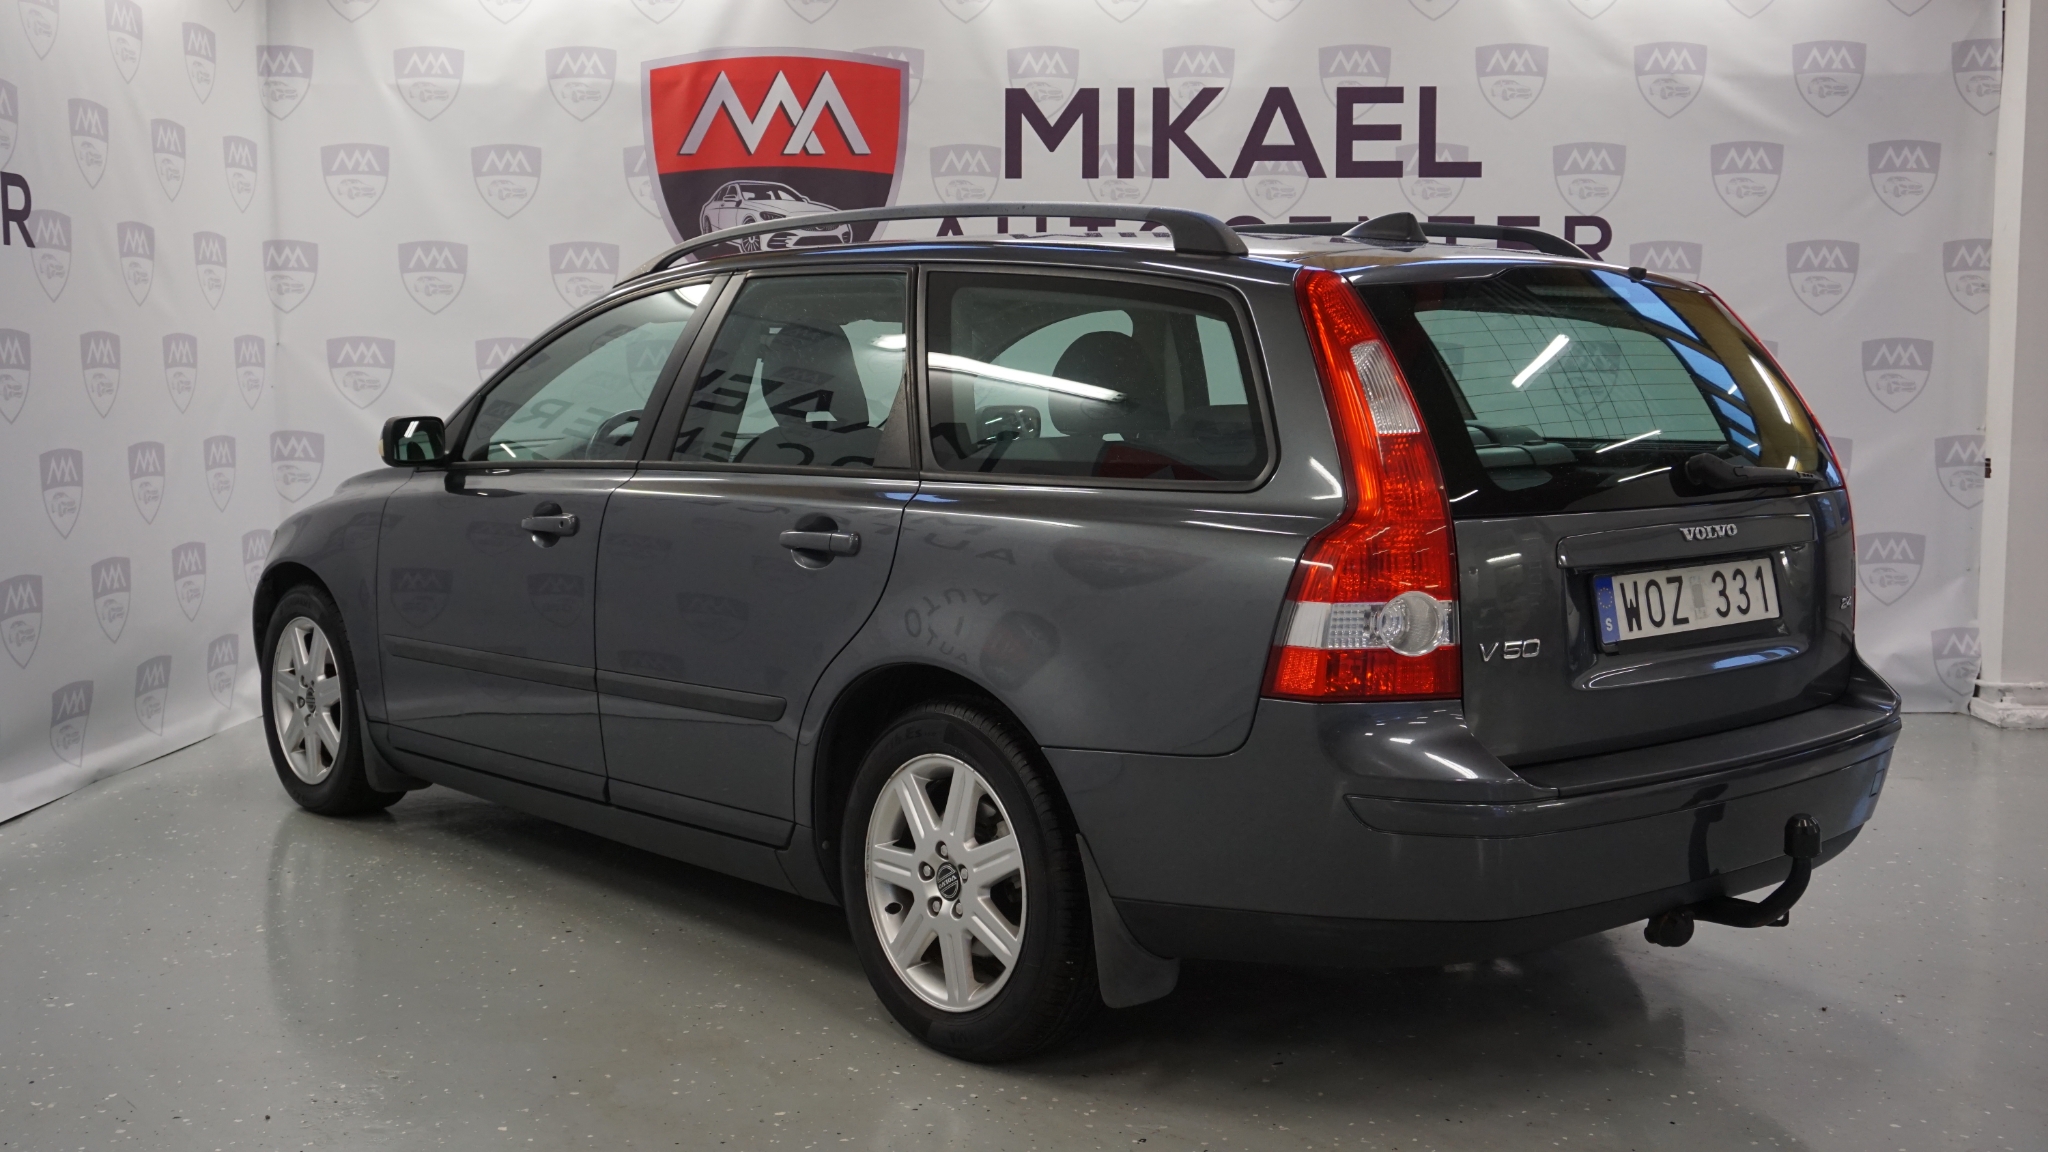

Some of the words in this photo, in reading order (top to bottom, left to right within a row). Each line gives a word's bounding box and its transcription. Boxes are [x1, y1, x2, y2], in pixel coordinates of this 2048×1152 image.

[1004, 86, 1482, 179] MIKAEL
[1680, 523, 1738, 542] VOLVO
[1619, 575, 1690, 632] WOZ
[1711, 565, 1769, 619] 331
[1605, 617, 1613, 632] S
[938, 875, 957, 889] VOLVO
